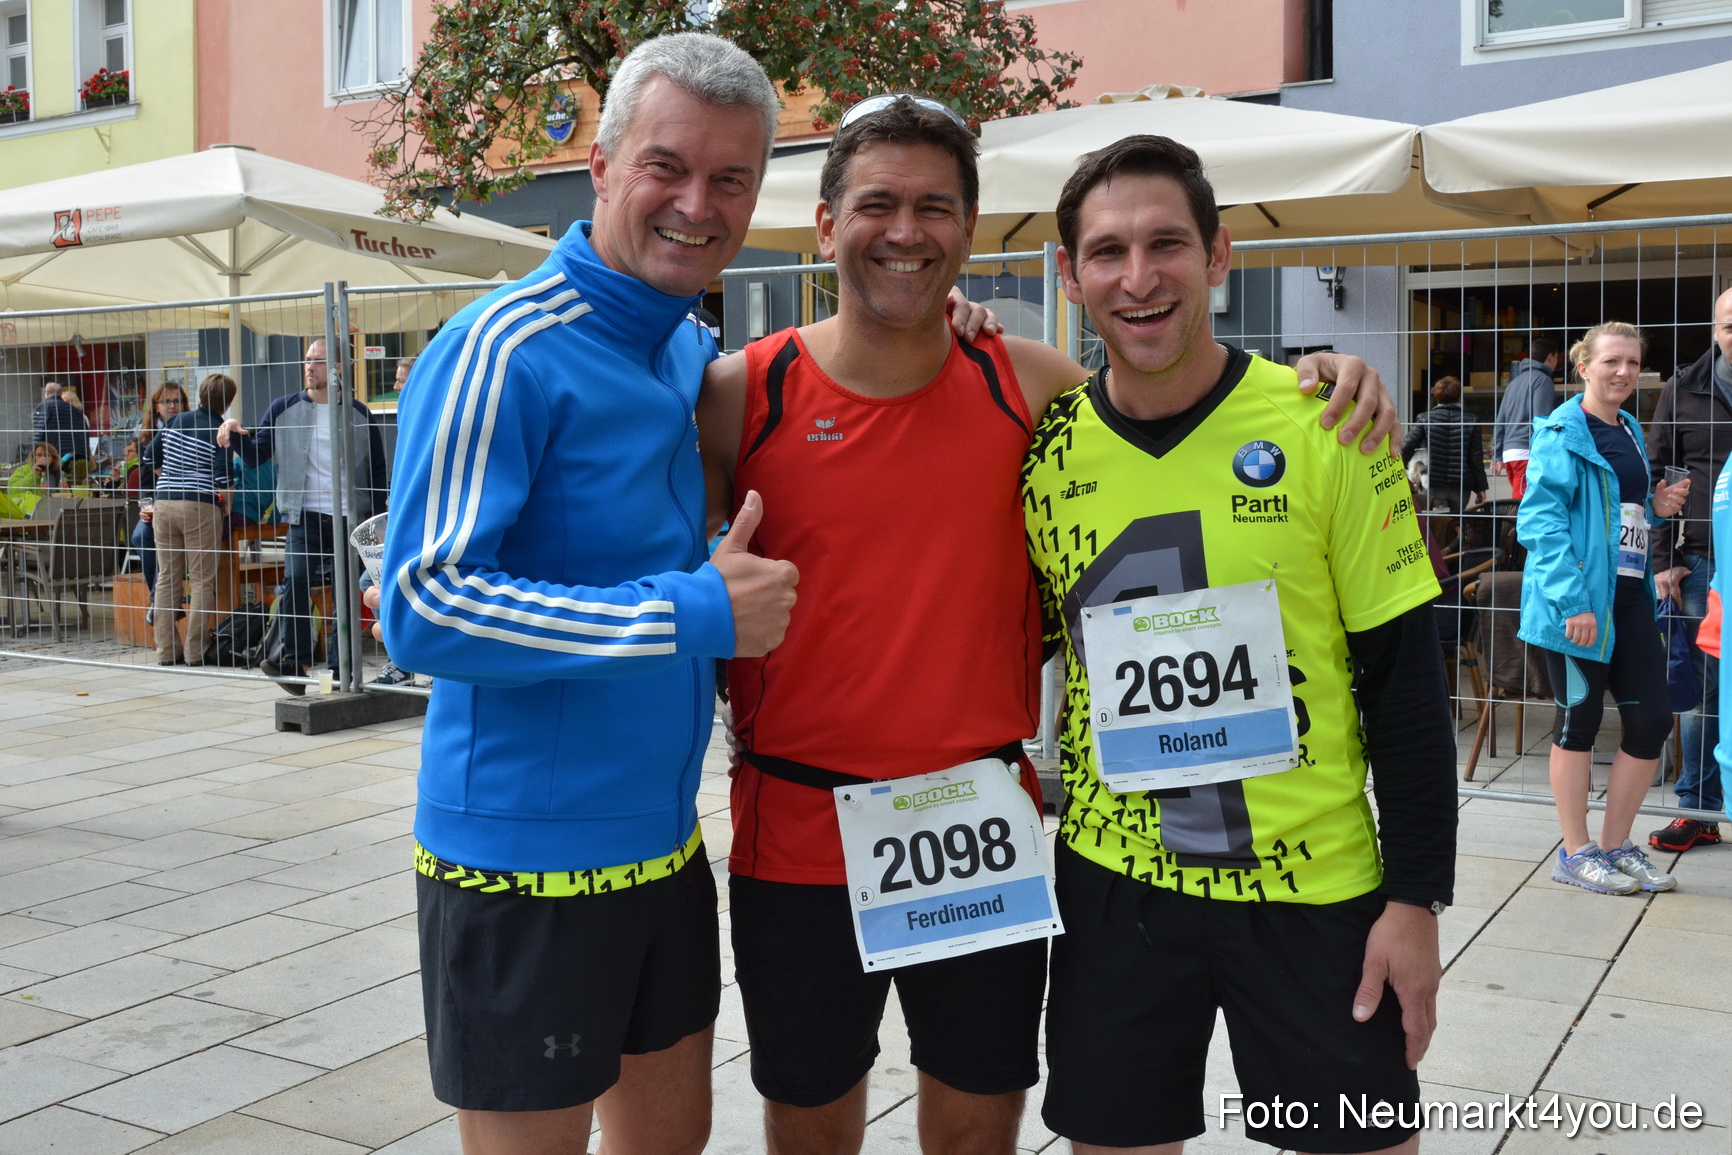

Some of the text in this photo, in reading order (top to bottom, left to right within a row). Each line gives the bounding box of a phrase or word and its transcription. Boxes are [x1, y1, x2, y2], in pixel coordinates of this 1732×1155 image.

[86, 206, 122, 222] PEPE
[84, 233, 122, 243] RESTAURANT
[350, 228, 437, 259] Tucher
[807, 431, 843, 442] erima
[1237, 441, 1282, 458] BMW
[1231, 494, 1288, 513] Partl
[1232, 513, 1289, 524] Neumarkt
[1620, 525, 1646, 550] 2183
[1396, 543, 1416, 559] THE
[1386, 549, 1424, 575] 100 YEARS
[1152, 606, 1220, 630] BOCK
[1153, 628, 1174, 636] inspired
[1197, 622, 1222, 630] concepts
[1115, 643, 1259, 717] 2694
[1100, 712, 1108, 723] D
[1158, 726, 1228, 754] Roland
[912, 780, 978, 808] BOCK
[913, 804, 932, 813] inspired
[956, 795, 980, 804] concepts
[873, 816, 1017, 894] 2098
[861, 891, 869, 902] B
[906, 893, 1005, 931] Ferdinand
